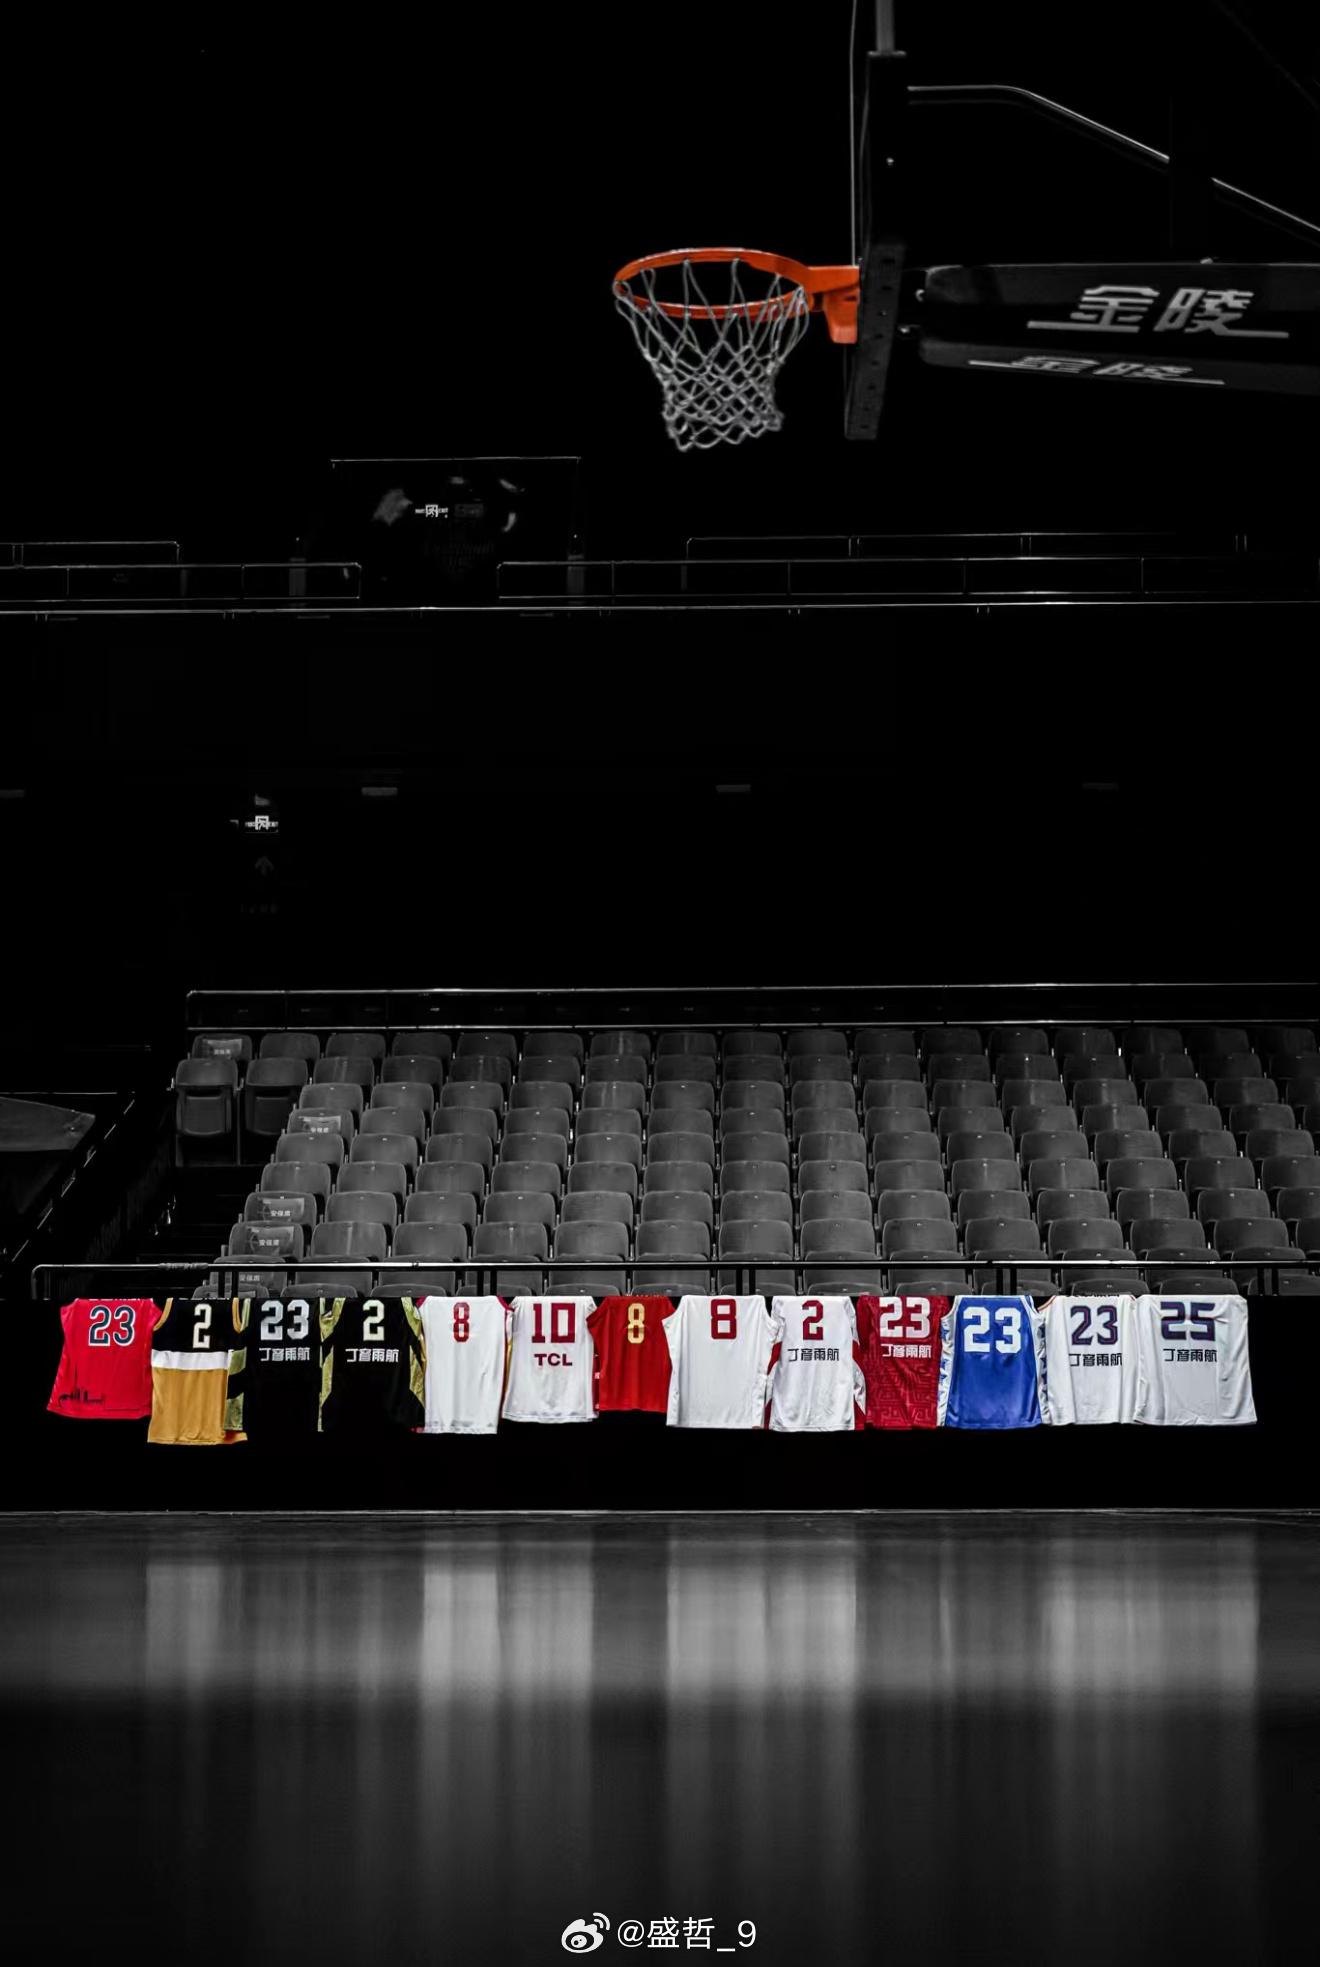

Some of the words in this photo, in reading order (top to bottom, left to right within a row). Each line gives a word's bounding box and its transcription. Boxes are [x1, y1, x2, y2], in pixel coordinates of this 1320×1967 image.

[1027, 284, 1290, 338] 金陵
[88, 1304, 136, 1347] 23
[192, 1303, 213, 1349] 2
[260, 1299, 310, 1341] 23
[362, 1299, 385, 1341] 2
[453, 1302, 470, 1343] 8
[531, 1303, 576, 1344] 10
[627, 1303, 646, 1344] 8
[711, 1299, 738, 1340] 8
[802, 1300, 824, 1341] 2
[879, 1296, 931, 1339] 23
[963, 1306, 1022, 1354] 23
[1070, 1304, 1119, 1346] 23
[1160, 1301, 1216, 1342] 25
[534, 1353, 573, 1367] TCL
